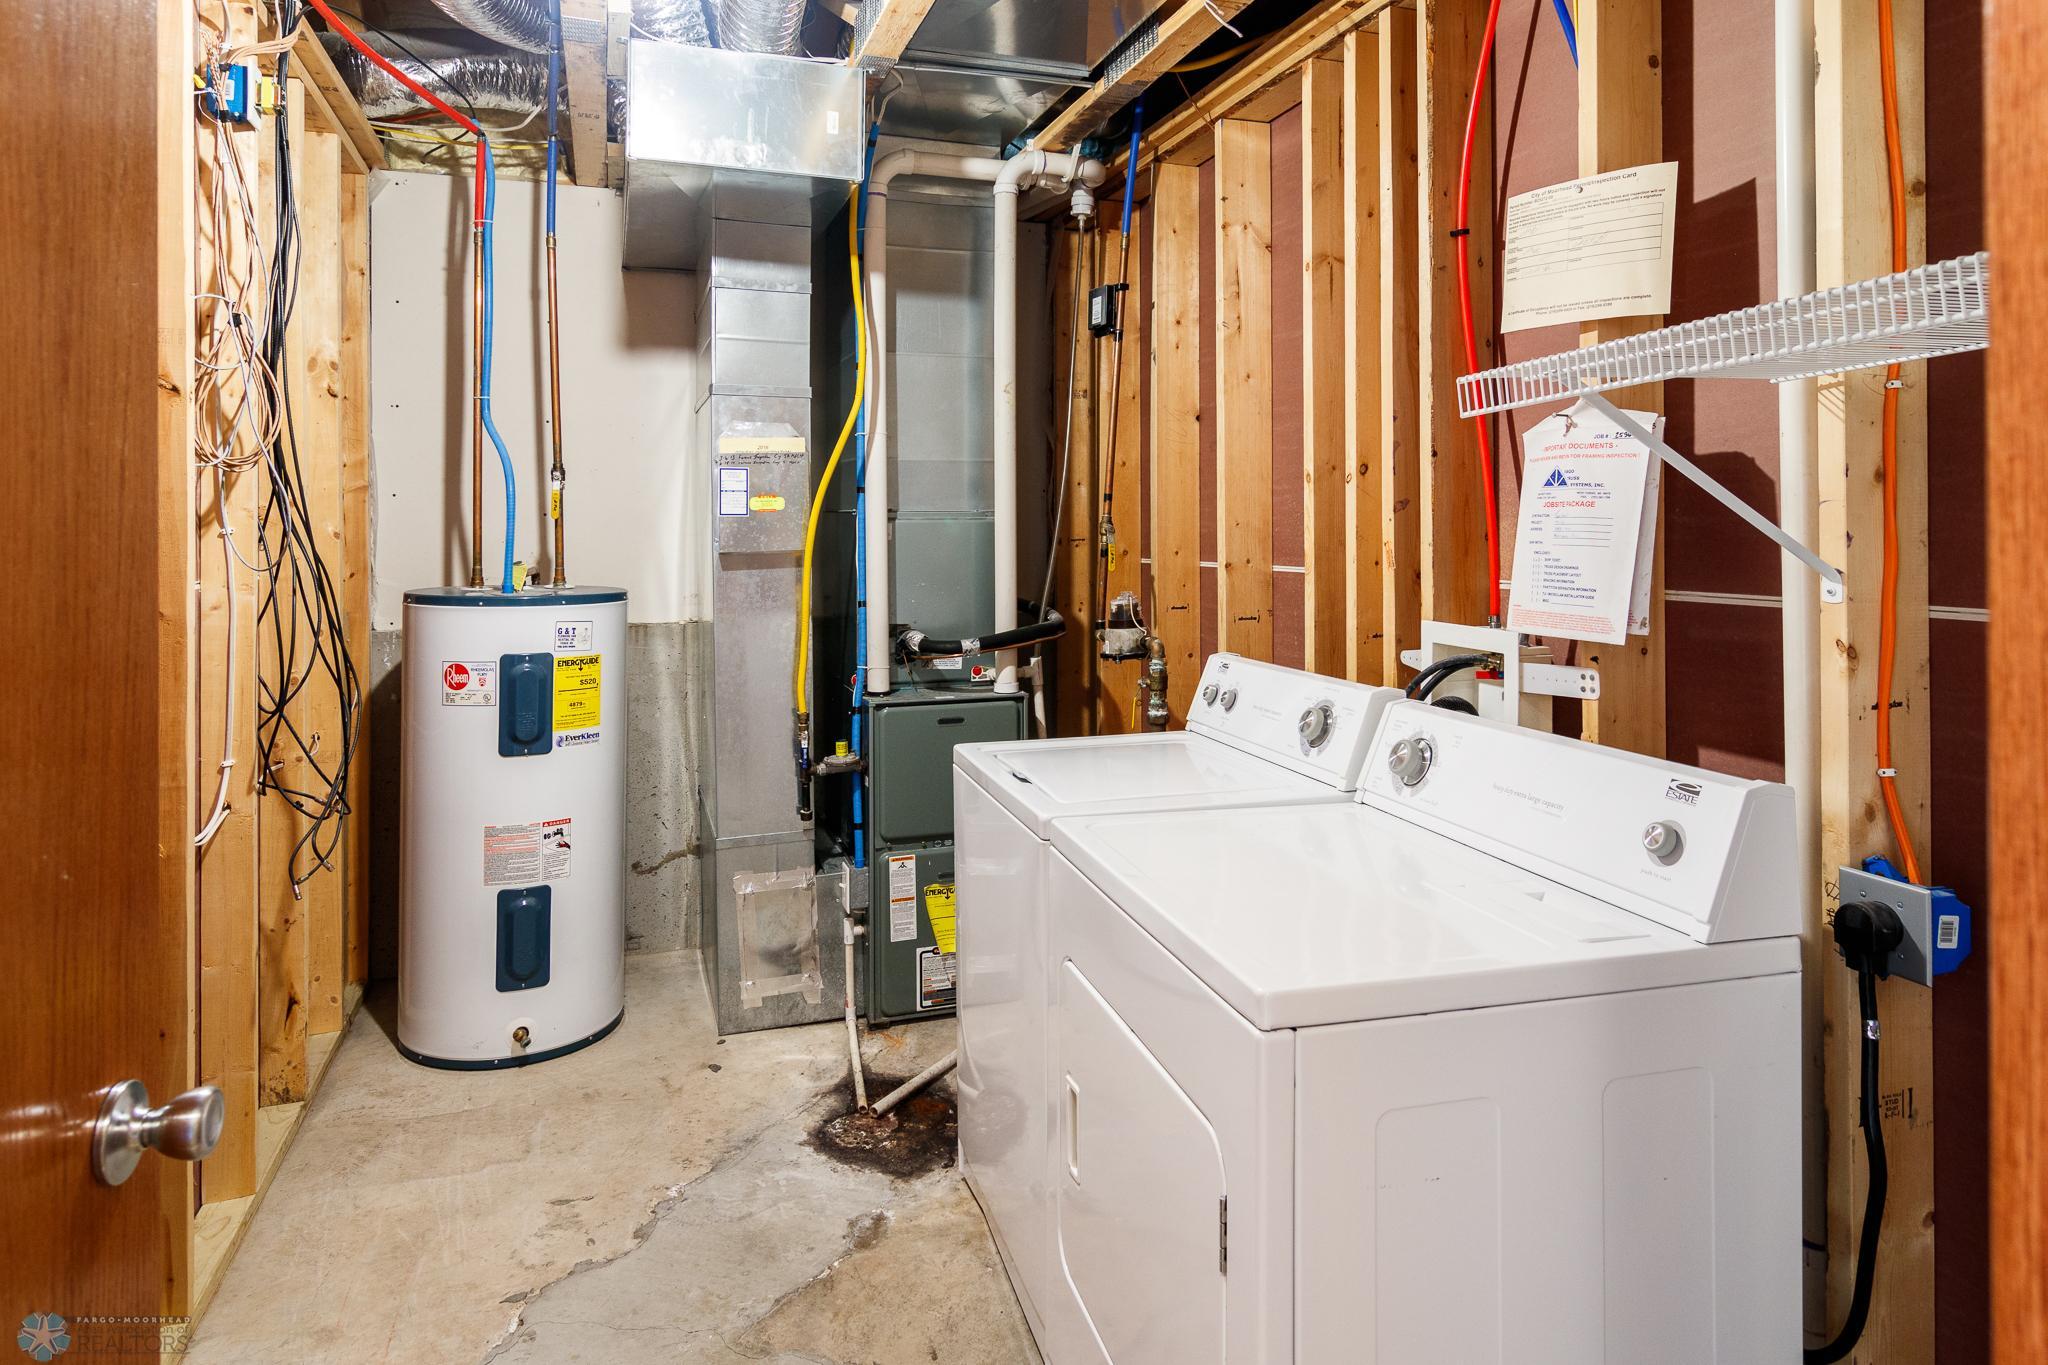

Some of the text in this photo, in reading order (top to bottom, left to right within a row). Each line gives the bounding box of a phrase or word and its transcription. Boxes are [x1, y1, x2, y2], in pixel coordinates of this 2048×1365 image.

[1622, 171, 1637, 180] Card
[1568, 442, 1614, 450] DOCUMENTS
[557, 627, 577, 635] G & T
[557, 657, 599, 671] ENERGYGUIDE
[446, 664, 469, 687] Rheem
[564, 732, 600, 742] EverKleen
[1526, 792, 1541, 805] large
[1541, 799, 1565, 811] capacity
[1665, 789, 1698, 805] ESTATE
[925, 886, 956, 900] ENERGYG
